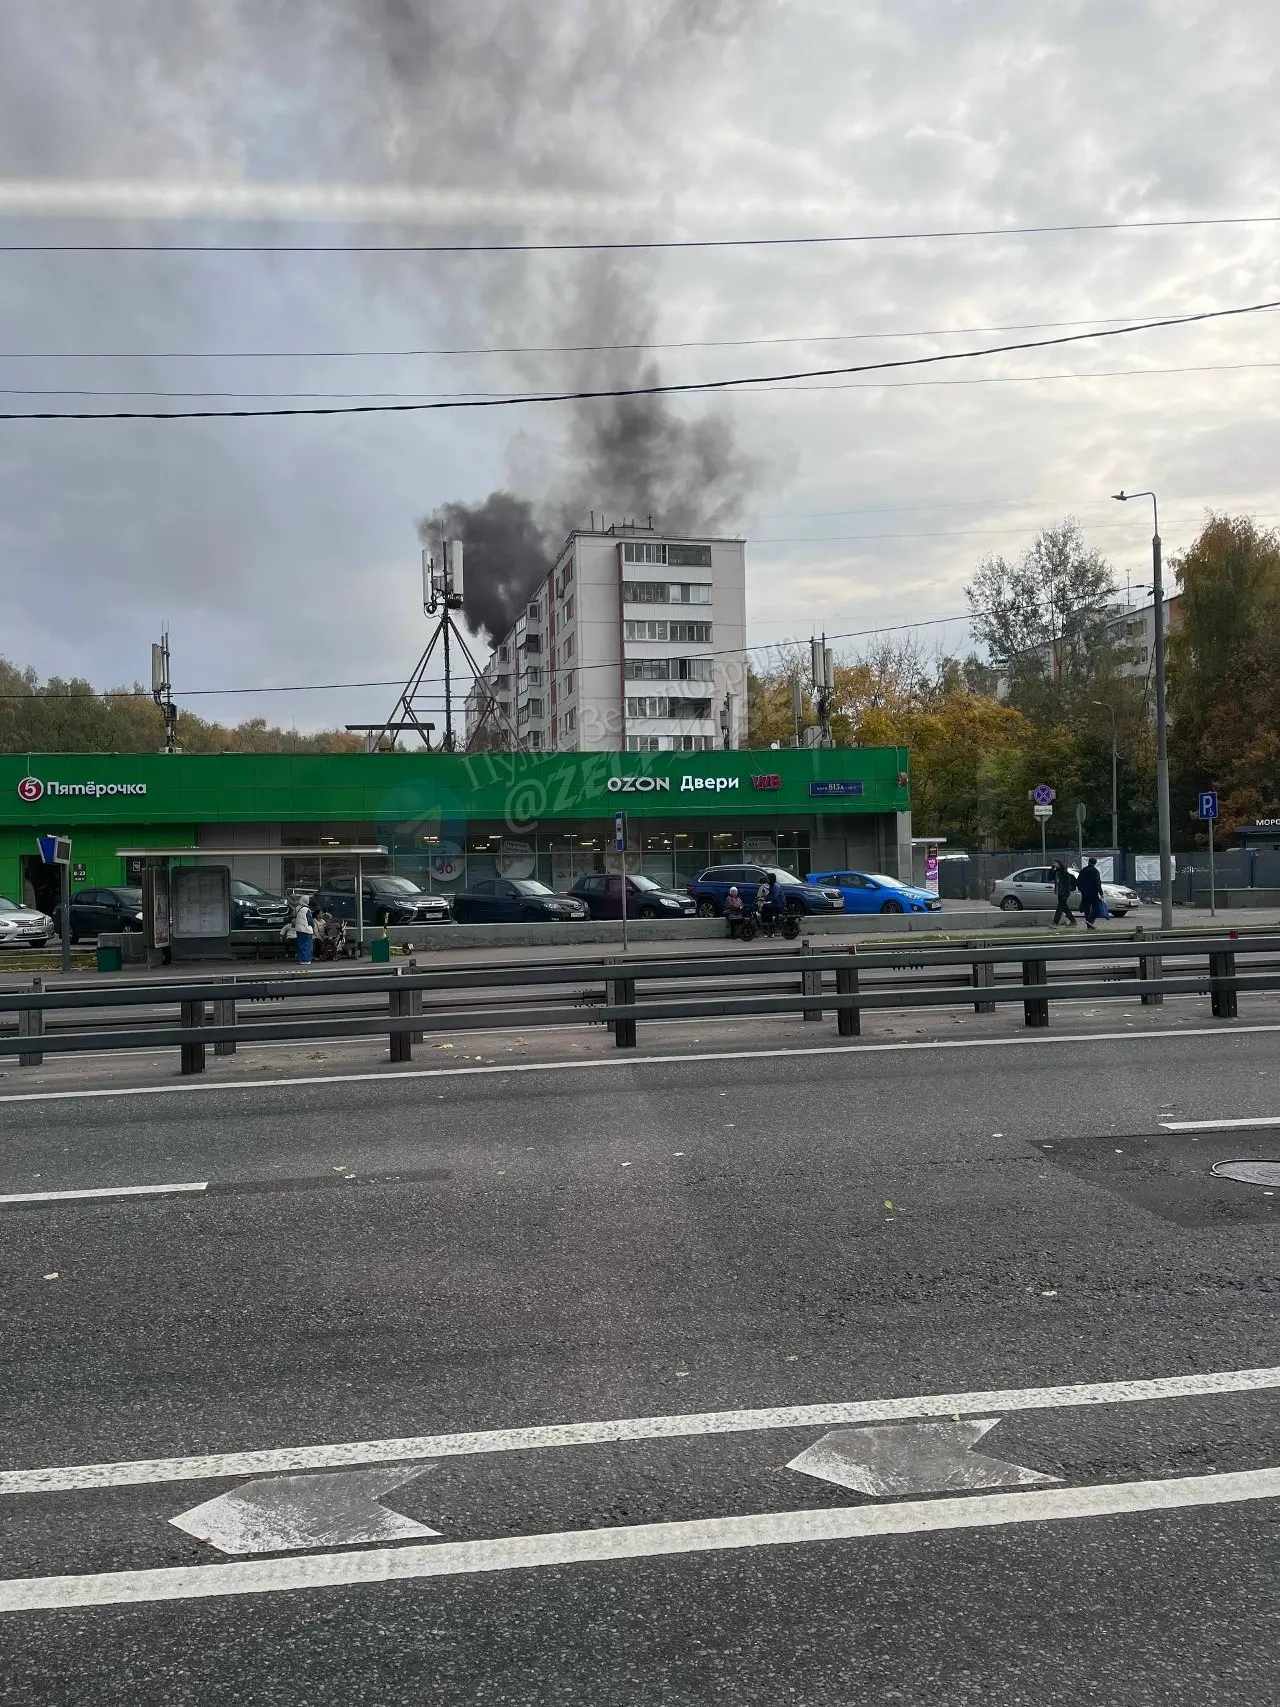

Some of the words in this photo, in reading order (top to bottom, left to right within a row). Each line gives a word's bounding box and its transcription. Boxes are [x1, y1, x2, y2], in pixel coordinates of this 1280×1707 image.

[24, 779, 38, 797] 5
[47, 781, 147, 797] Пятёрочка
[607, 776, 670, 792] OZON
[680, 775, 740, 792] Двери
[751, 773, 782, 791] WB
[1202, 795, 1213, 816] P
